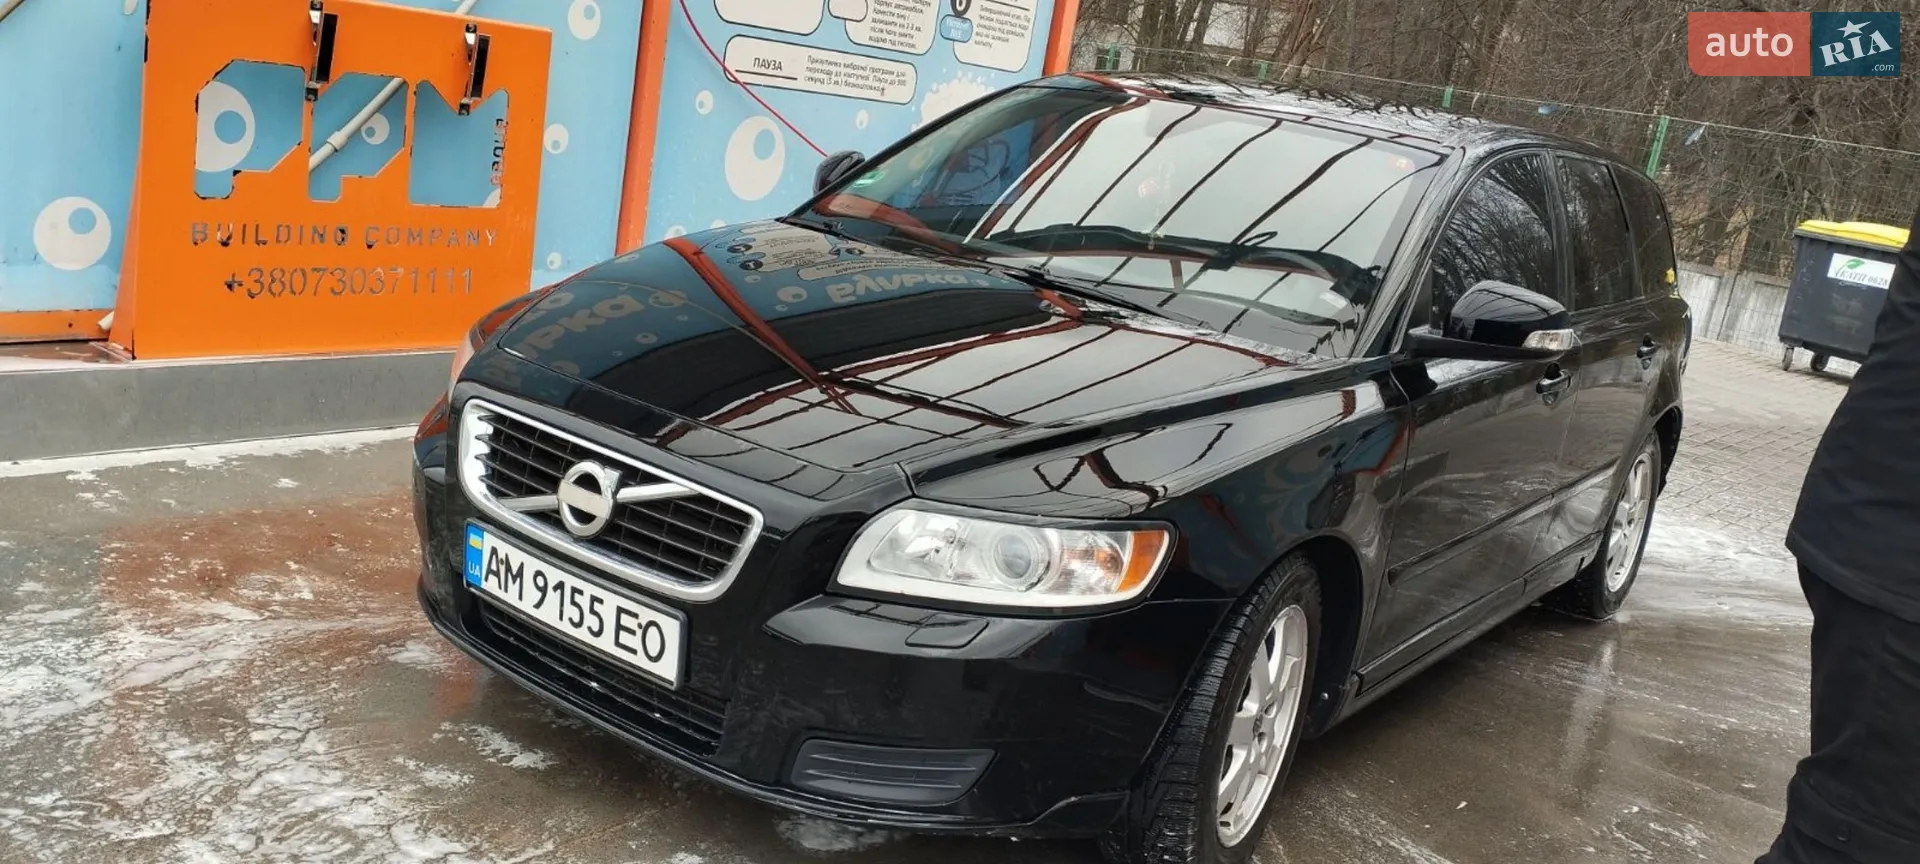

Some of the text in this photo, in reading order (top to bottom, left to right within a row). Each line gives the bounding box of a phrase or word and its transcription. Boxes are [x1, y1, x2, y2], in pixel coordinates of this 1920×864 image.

[753, 57, 783, 71] ПАУЗА
[191, 222, 497, 249] BUILDING COMPANY
[223, 266, 473, 299] +380730371111
[468, 560, 481, 577] UA
[484, 545, 666, 663] AM 9155 EO
